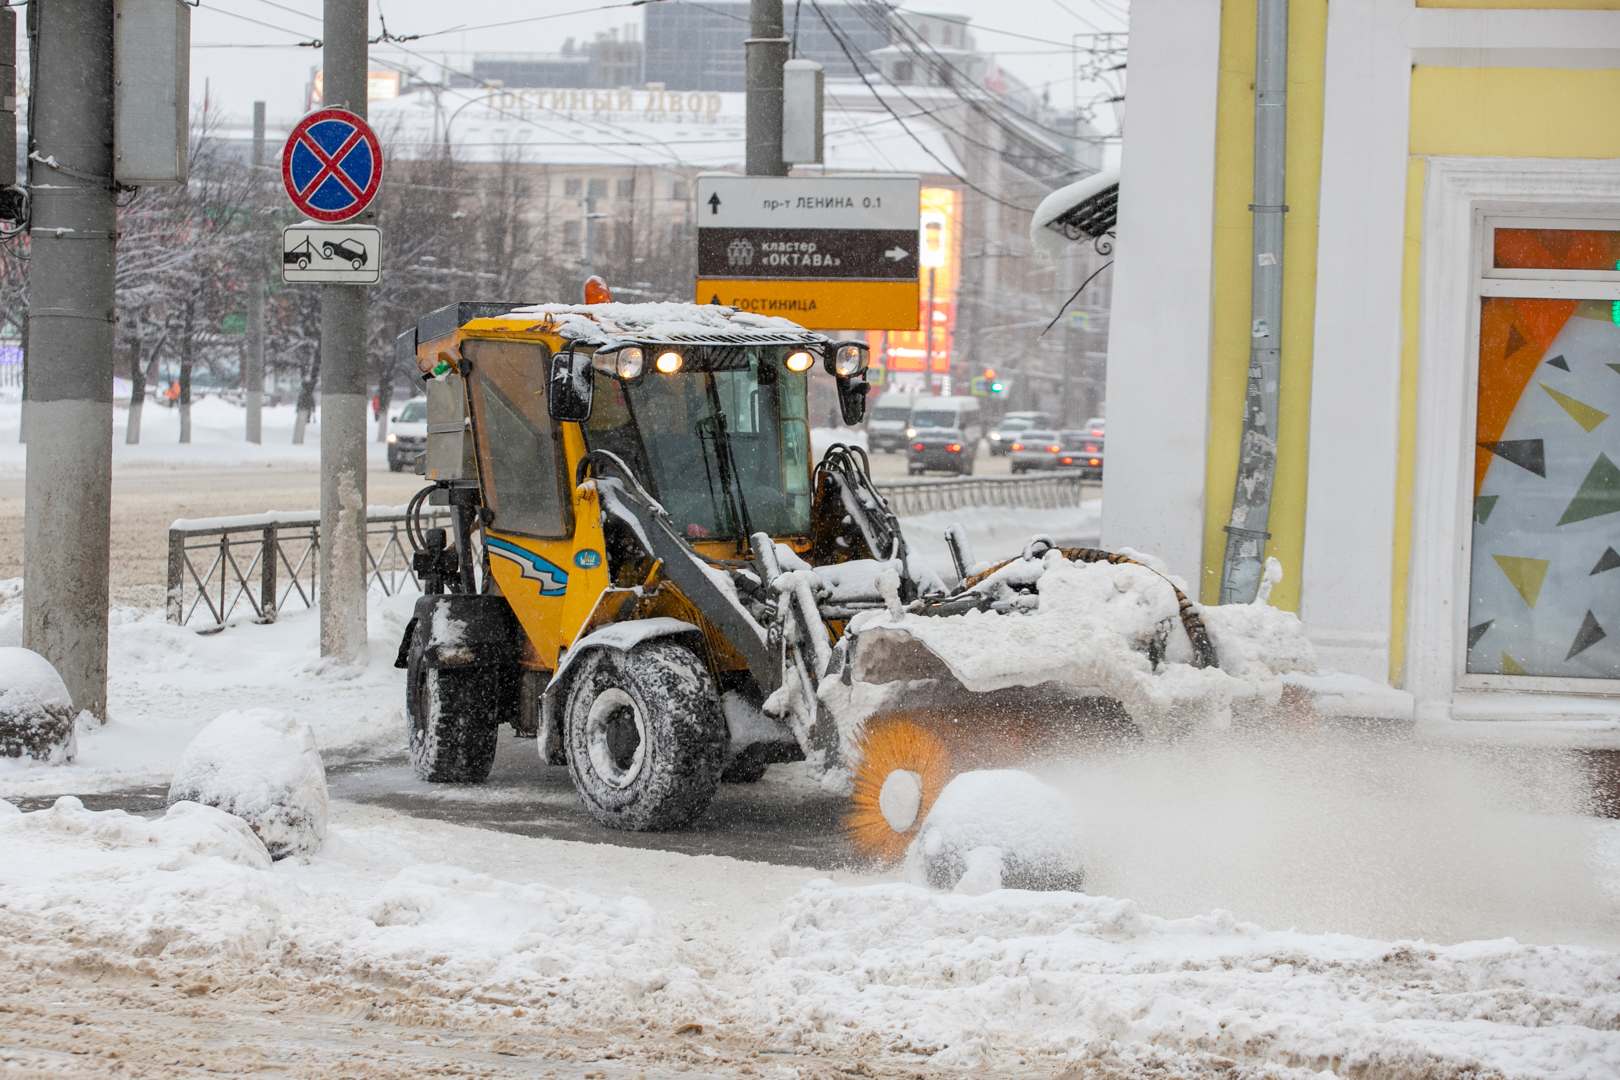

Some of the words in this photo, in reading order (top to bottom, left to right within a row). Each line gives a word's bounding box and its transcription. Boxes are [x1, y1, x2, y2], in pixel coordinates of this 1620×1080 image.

[485, 79, 633, 111] Гостиный
[644, 82, 722, 120] Двор
[763, 199, 791, 211] пр-т
[796, 197, 854, 208] ЛЕНИНА
[862, 197, 882, 208] 0.1
[762, 242, 817, 254] кластер
[762, 254, 841, 266] «ОКТАВА»
[732, 298, 818, 311] ГОСТИНИЦА
